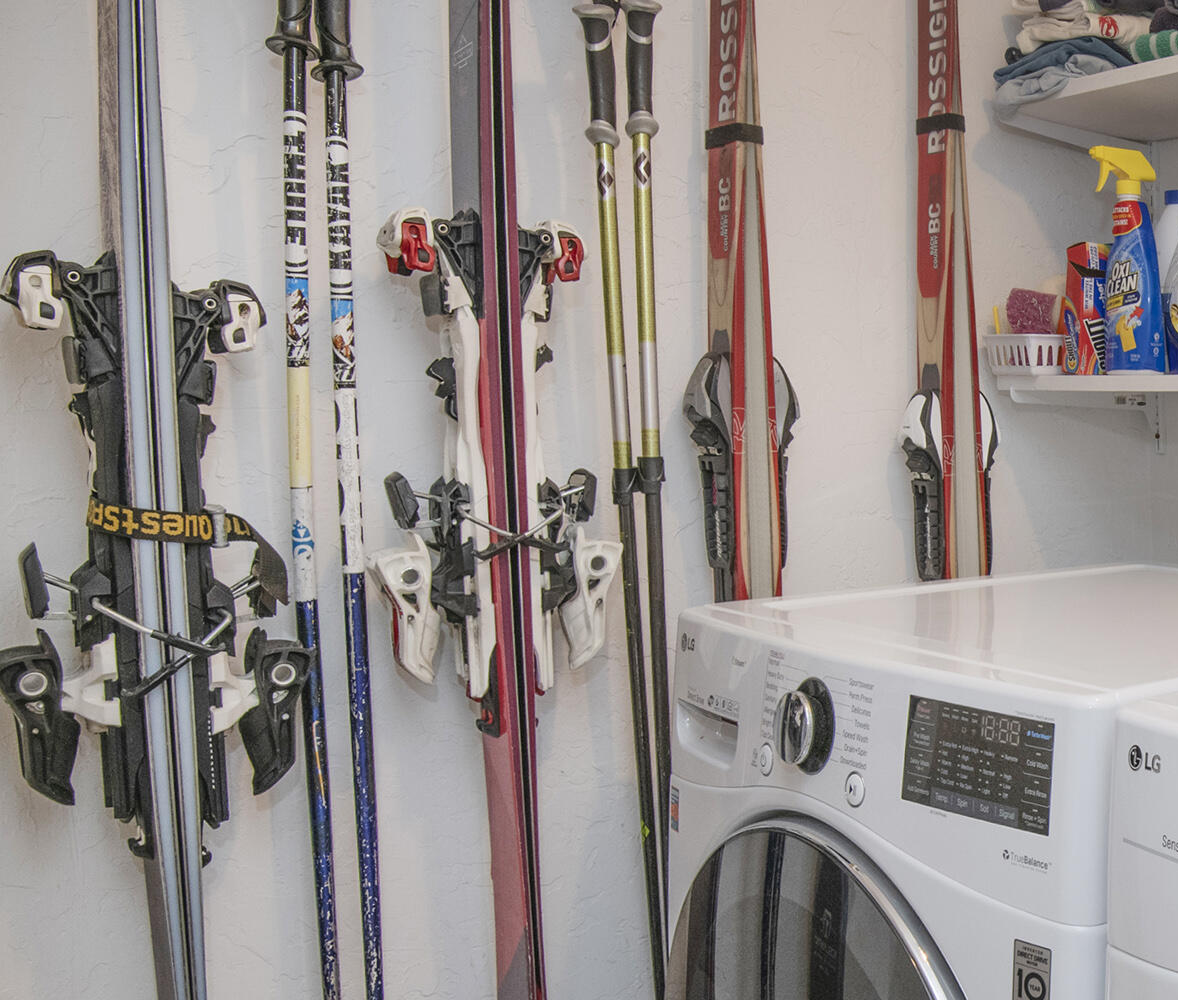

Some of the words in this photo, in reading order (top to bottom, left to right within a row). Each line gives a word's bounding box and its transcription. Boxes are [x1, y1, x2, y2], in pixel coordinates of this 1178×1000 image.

[718, 176, 731, 212] BC
[928, 202, 941, 235] BC
[1112, 260, 1131, 281] OXI
[1107, 273, 1138, 298] CLEAN
[687, 637, 695, 652] LG
[1144, 752, 1162, 773] LG
[999, 808, 1016, 820] Signal
[1017, 950, 1034, 960] DIRECT
[1034, 953, 1049, 965] DRIVE
[1029, 984, 1041, 992] YEAR
